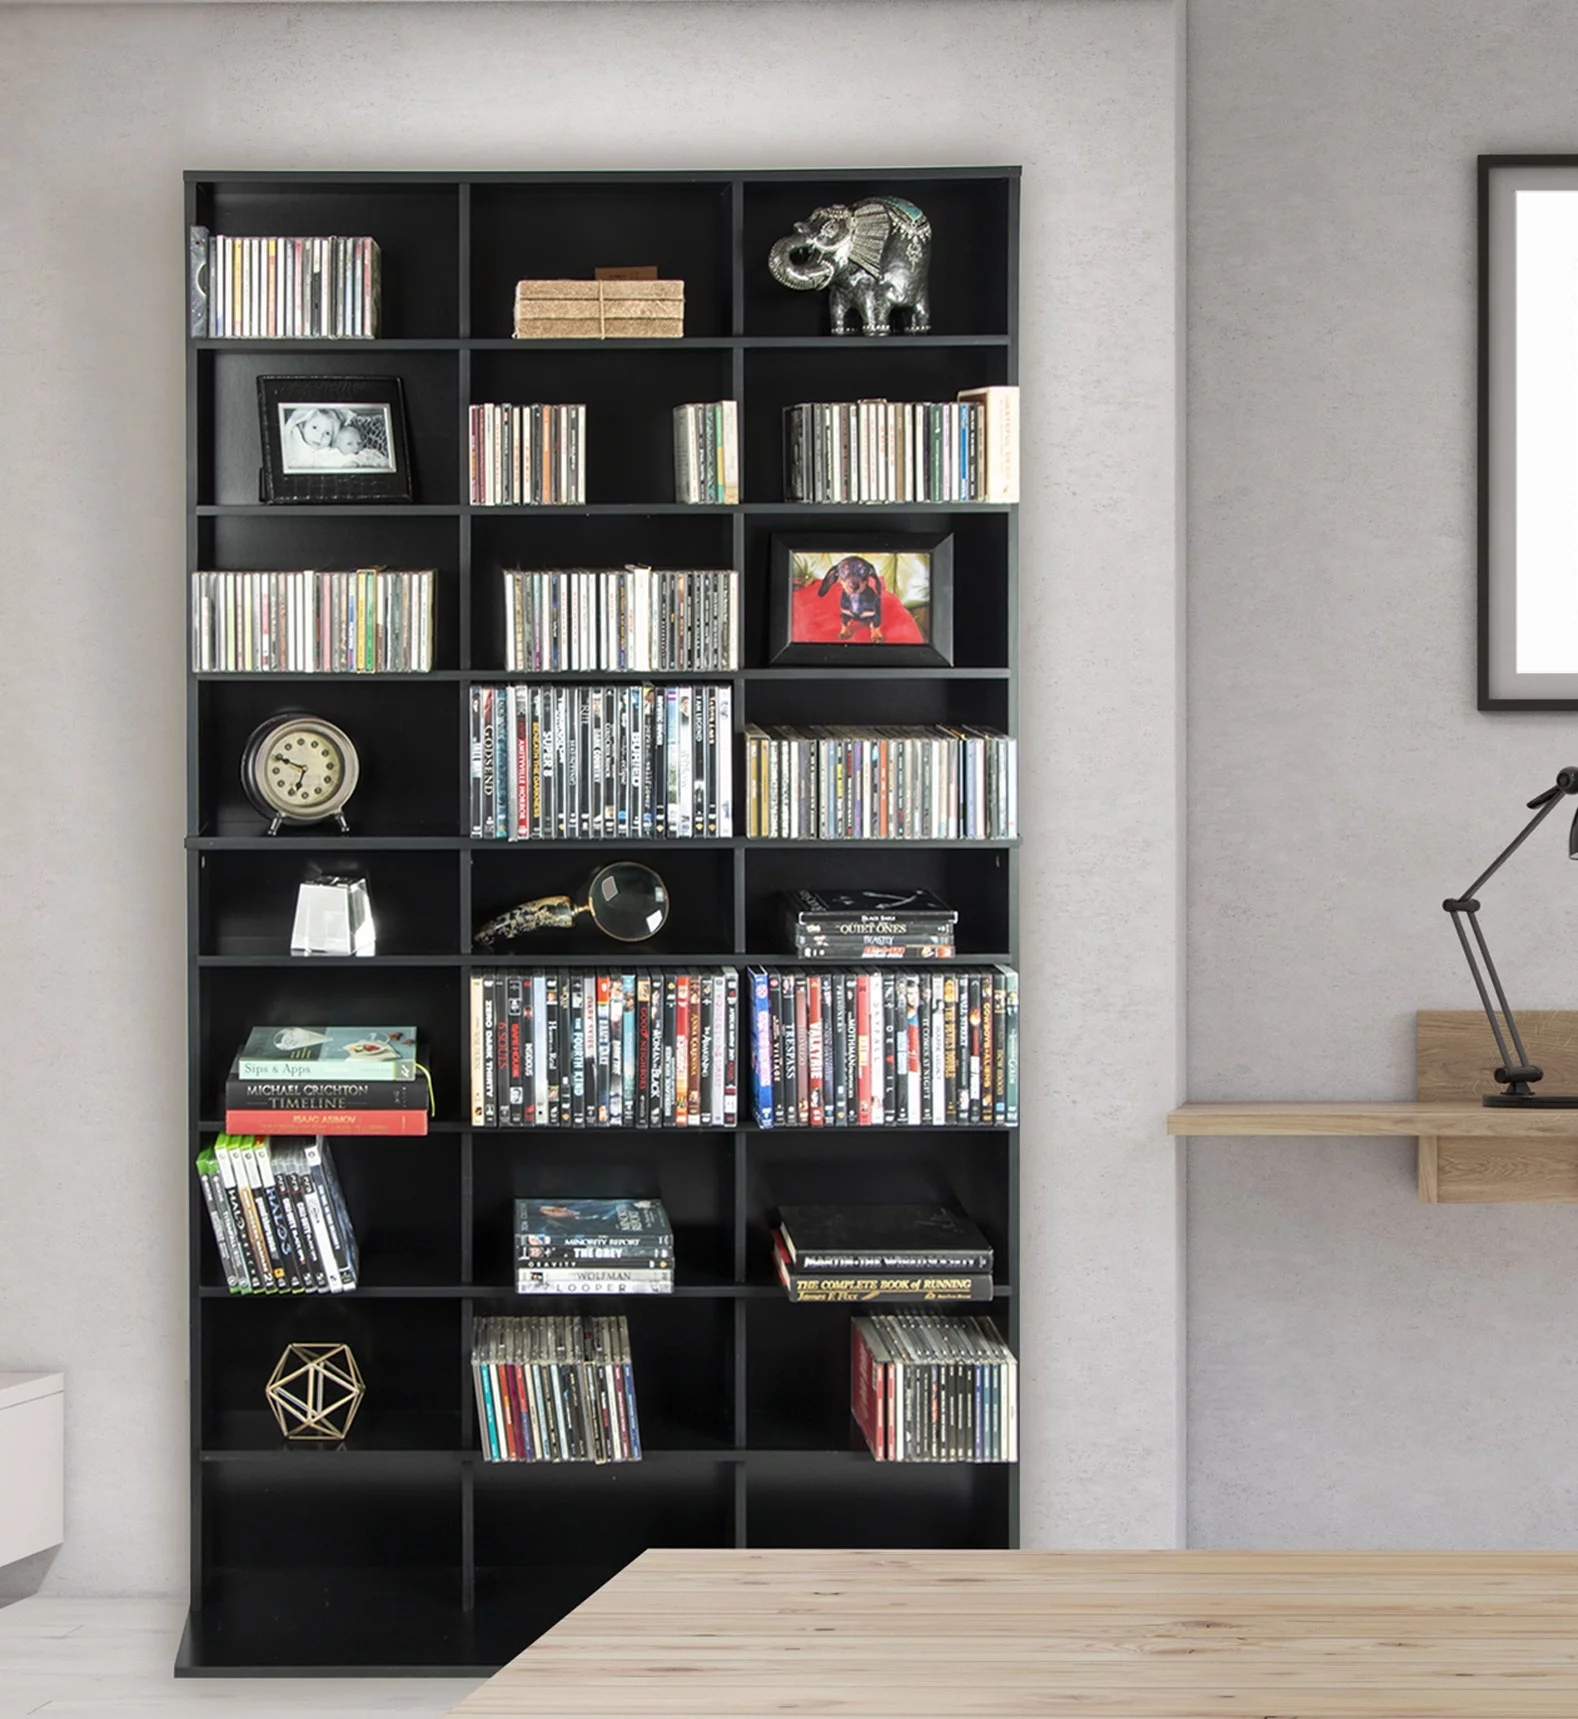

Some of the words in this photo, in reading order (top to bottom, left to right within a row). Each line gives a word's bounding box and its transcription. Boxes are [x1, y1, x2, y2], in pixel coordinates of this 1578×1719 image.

[580, 705, 589, 725] RITE
[696, 700, 701, 711] AM
[484, 725, 494, 795] GODSEND
[543, 731, 552, 767] SUPER
[632, 732, 640, 787] BURIED
[543, 769, 552, 777] 8
[645, 761, 653, 809] wallflower
[840, 923, 875, 935] QUIET
[876, 923, 907, 934] ONES
[640, 1007, 648, 1038] GOOD
[923, 1018, 928, 1026] IT
[960, 1016, 968, 1046] STREET
[498, 1032, 507, 1069] SOULS
[574, 1032, 583, 1068] FOURTH
[652, 1028, 660, 1062] WOMAN
[690, 1037, 698, 1076] KARENINA
[785, 1023, 795, 1079] TRESPASS
[810, 1021, 821, 1078] VALKYRIE
[244, 1062, 269, 1077] Sips
[282, 1062, 311, 1077] Apps
[651, 1068, 661, 1098] BLACK
[247, 1084, 301, 1096] MICHAEL
[303, 1084, 369, 1096] CRICHTON
[574, 1071, 583, 1096] KIND
[268, 1097, 347, 1109] TIMELINE
[293, 1115, 319, 1124] ISAAC
[321, 1115, 357, 1124] ASIMOV
[303, 1176, 312, 1193] PS3
[228, 1189, 245, 1230] HALO
[266, 1188, 288, 1241] HALO
[280, 1242, 291, 1255] 3
[222, 1211, 236, 1248] TITANFALL
[573, 1248, 595, 1258] THE
[595, 1248, 623, 1258] GREY
[557, 1284, 627, 1292] LOOPER
[576, 1272, 631, 1281] WOLFMAN
[797, 1280, 819, 1290] THE
[821, 1280, 878, 1289] COMPLETE
[880, 1280, 910, 1289] BOOK
[910, 1280, 922, 1291] of
[923, 1279, 972, 1289] RUNNING
[797, 1291, 827, 1301] James
[837, 1291, 859, 1300] Fixx
